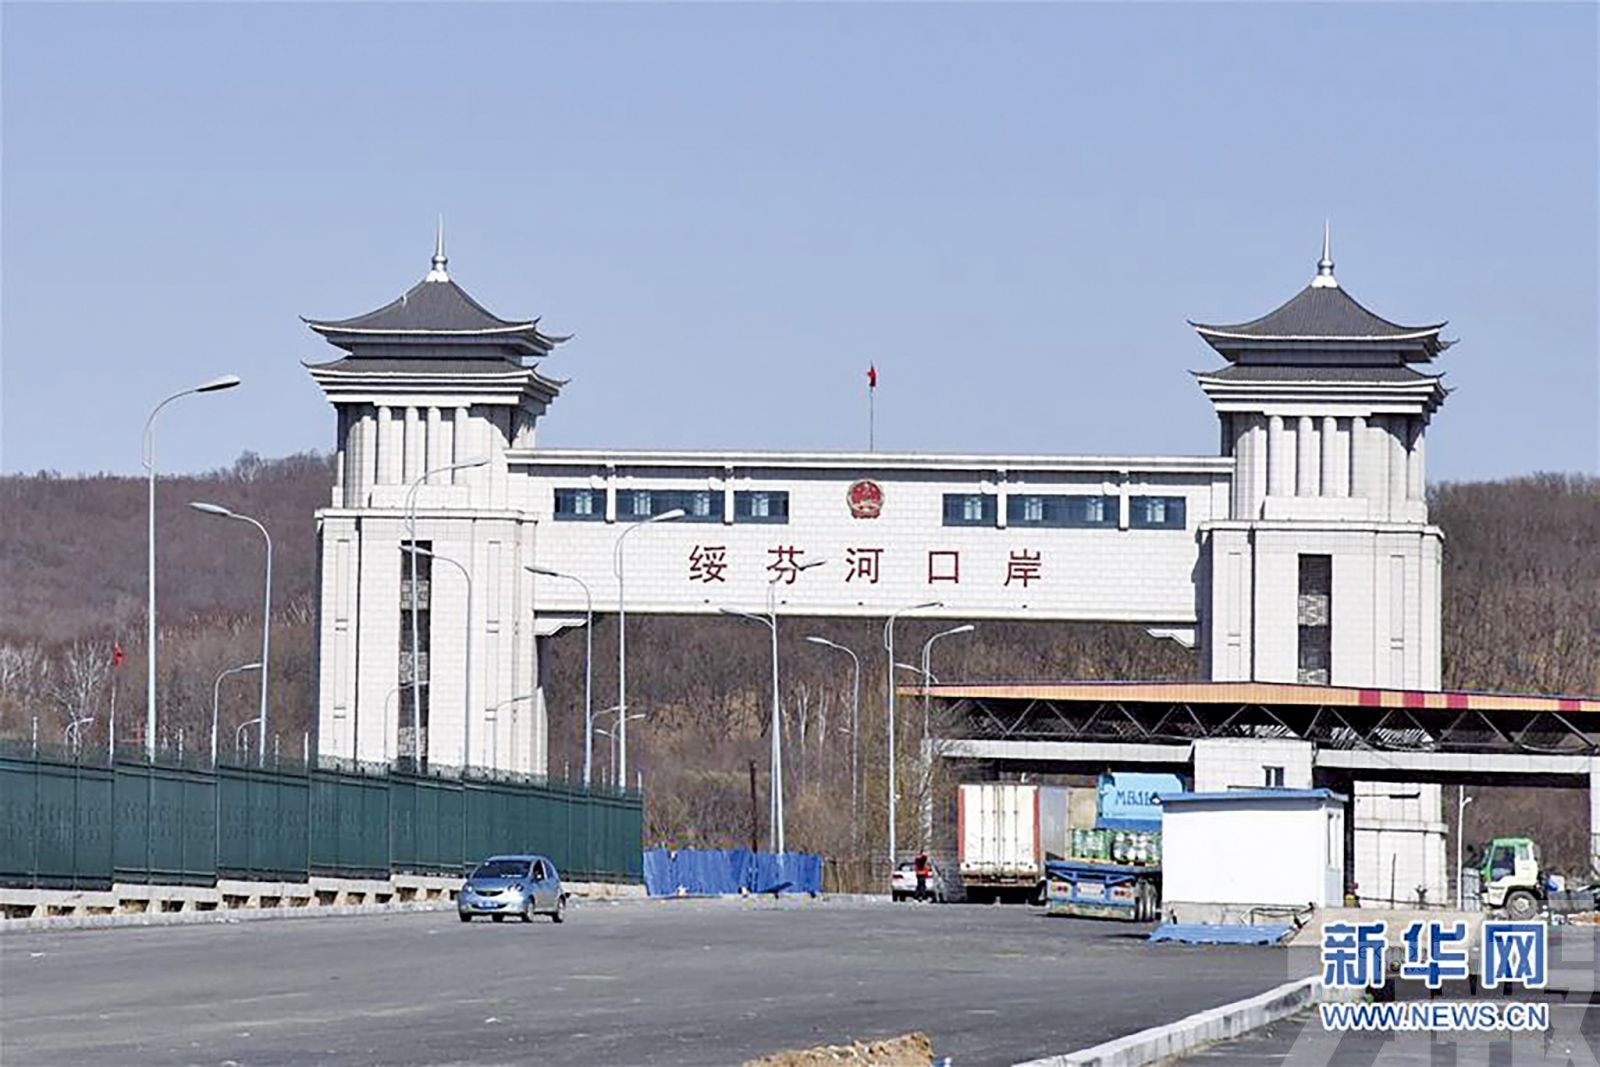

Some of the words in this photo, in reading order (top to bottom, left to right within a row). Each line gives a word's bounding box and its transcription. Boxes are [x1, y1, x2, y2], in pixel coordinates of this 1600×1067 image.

[688, 544, 1042, 588] 绥芬河口岸
